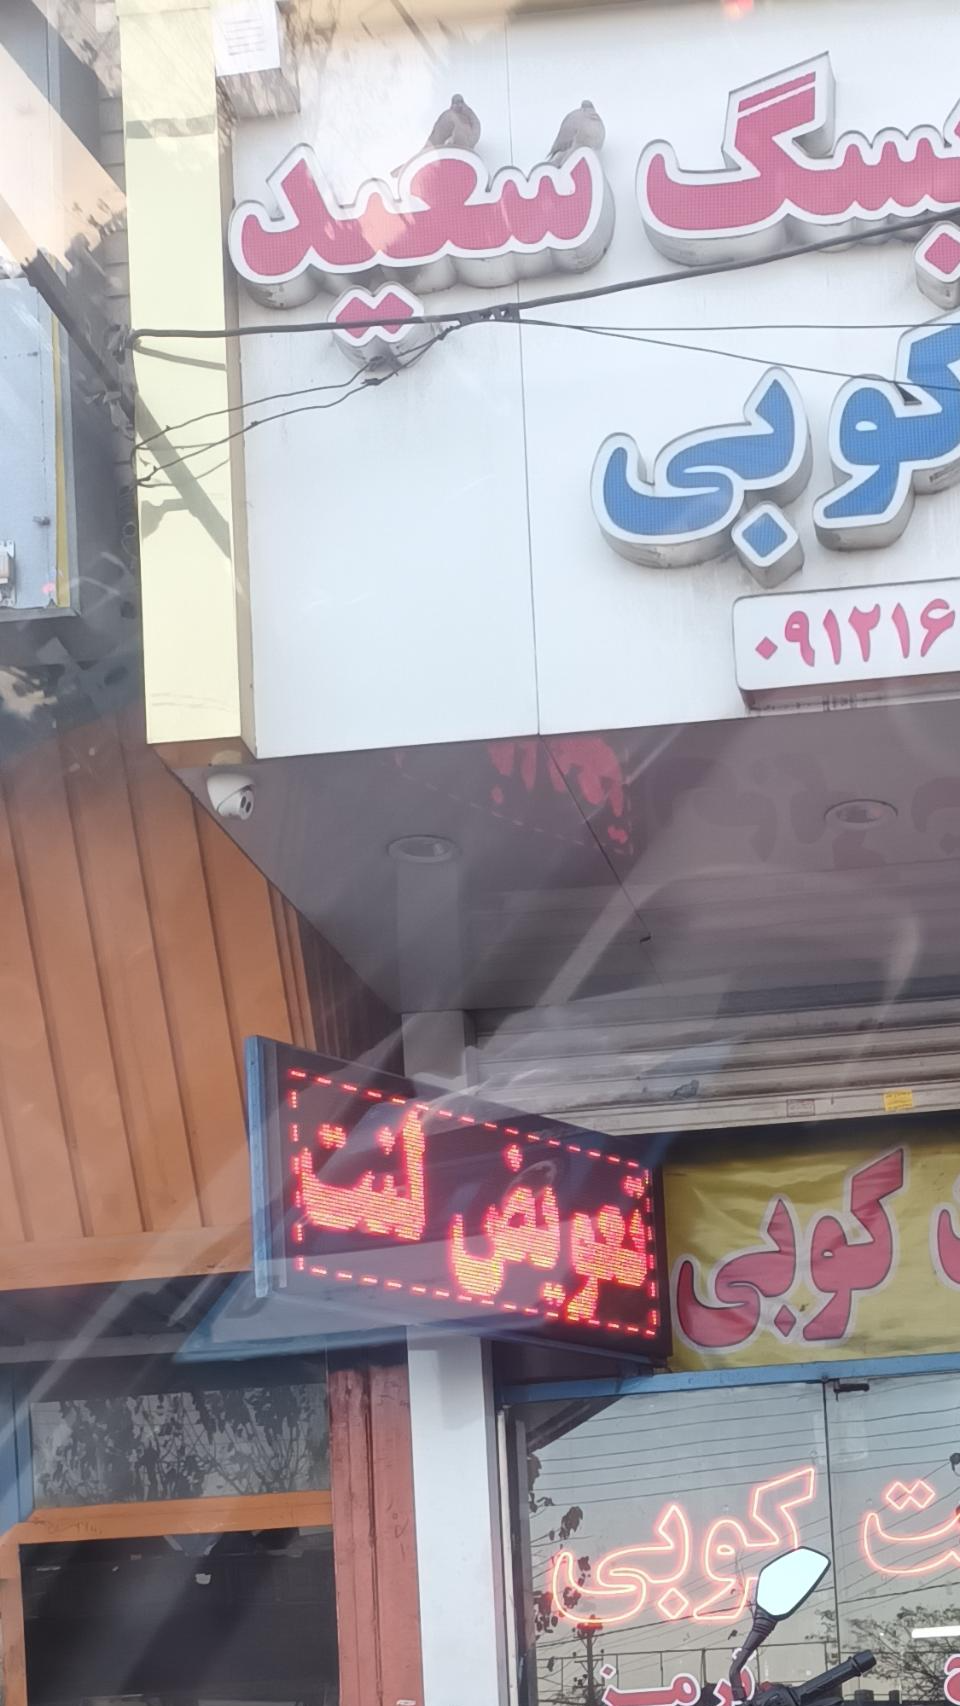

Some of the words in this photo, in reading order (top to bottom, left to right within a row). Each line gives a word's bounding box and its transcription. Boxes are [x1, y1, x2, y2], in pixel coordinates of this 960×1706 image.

[229, 144, 604, 347] سعید
[299, 1106, 427, 1241] لنت
[451, 1142, 650, 1321] تعویض
[674, 1143, 906, 1350] کوبی
[551, 1464, 816, 1627] کوبی
